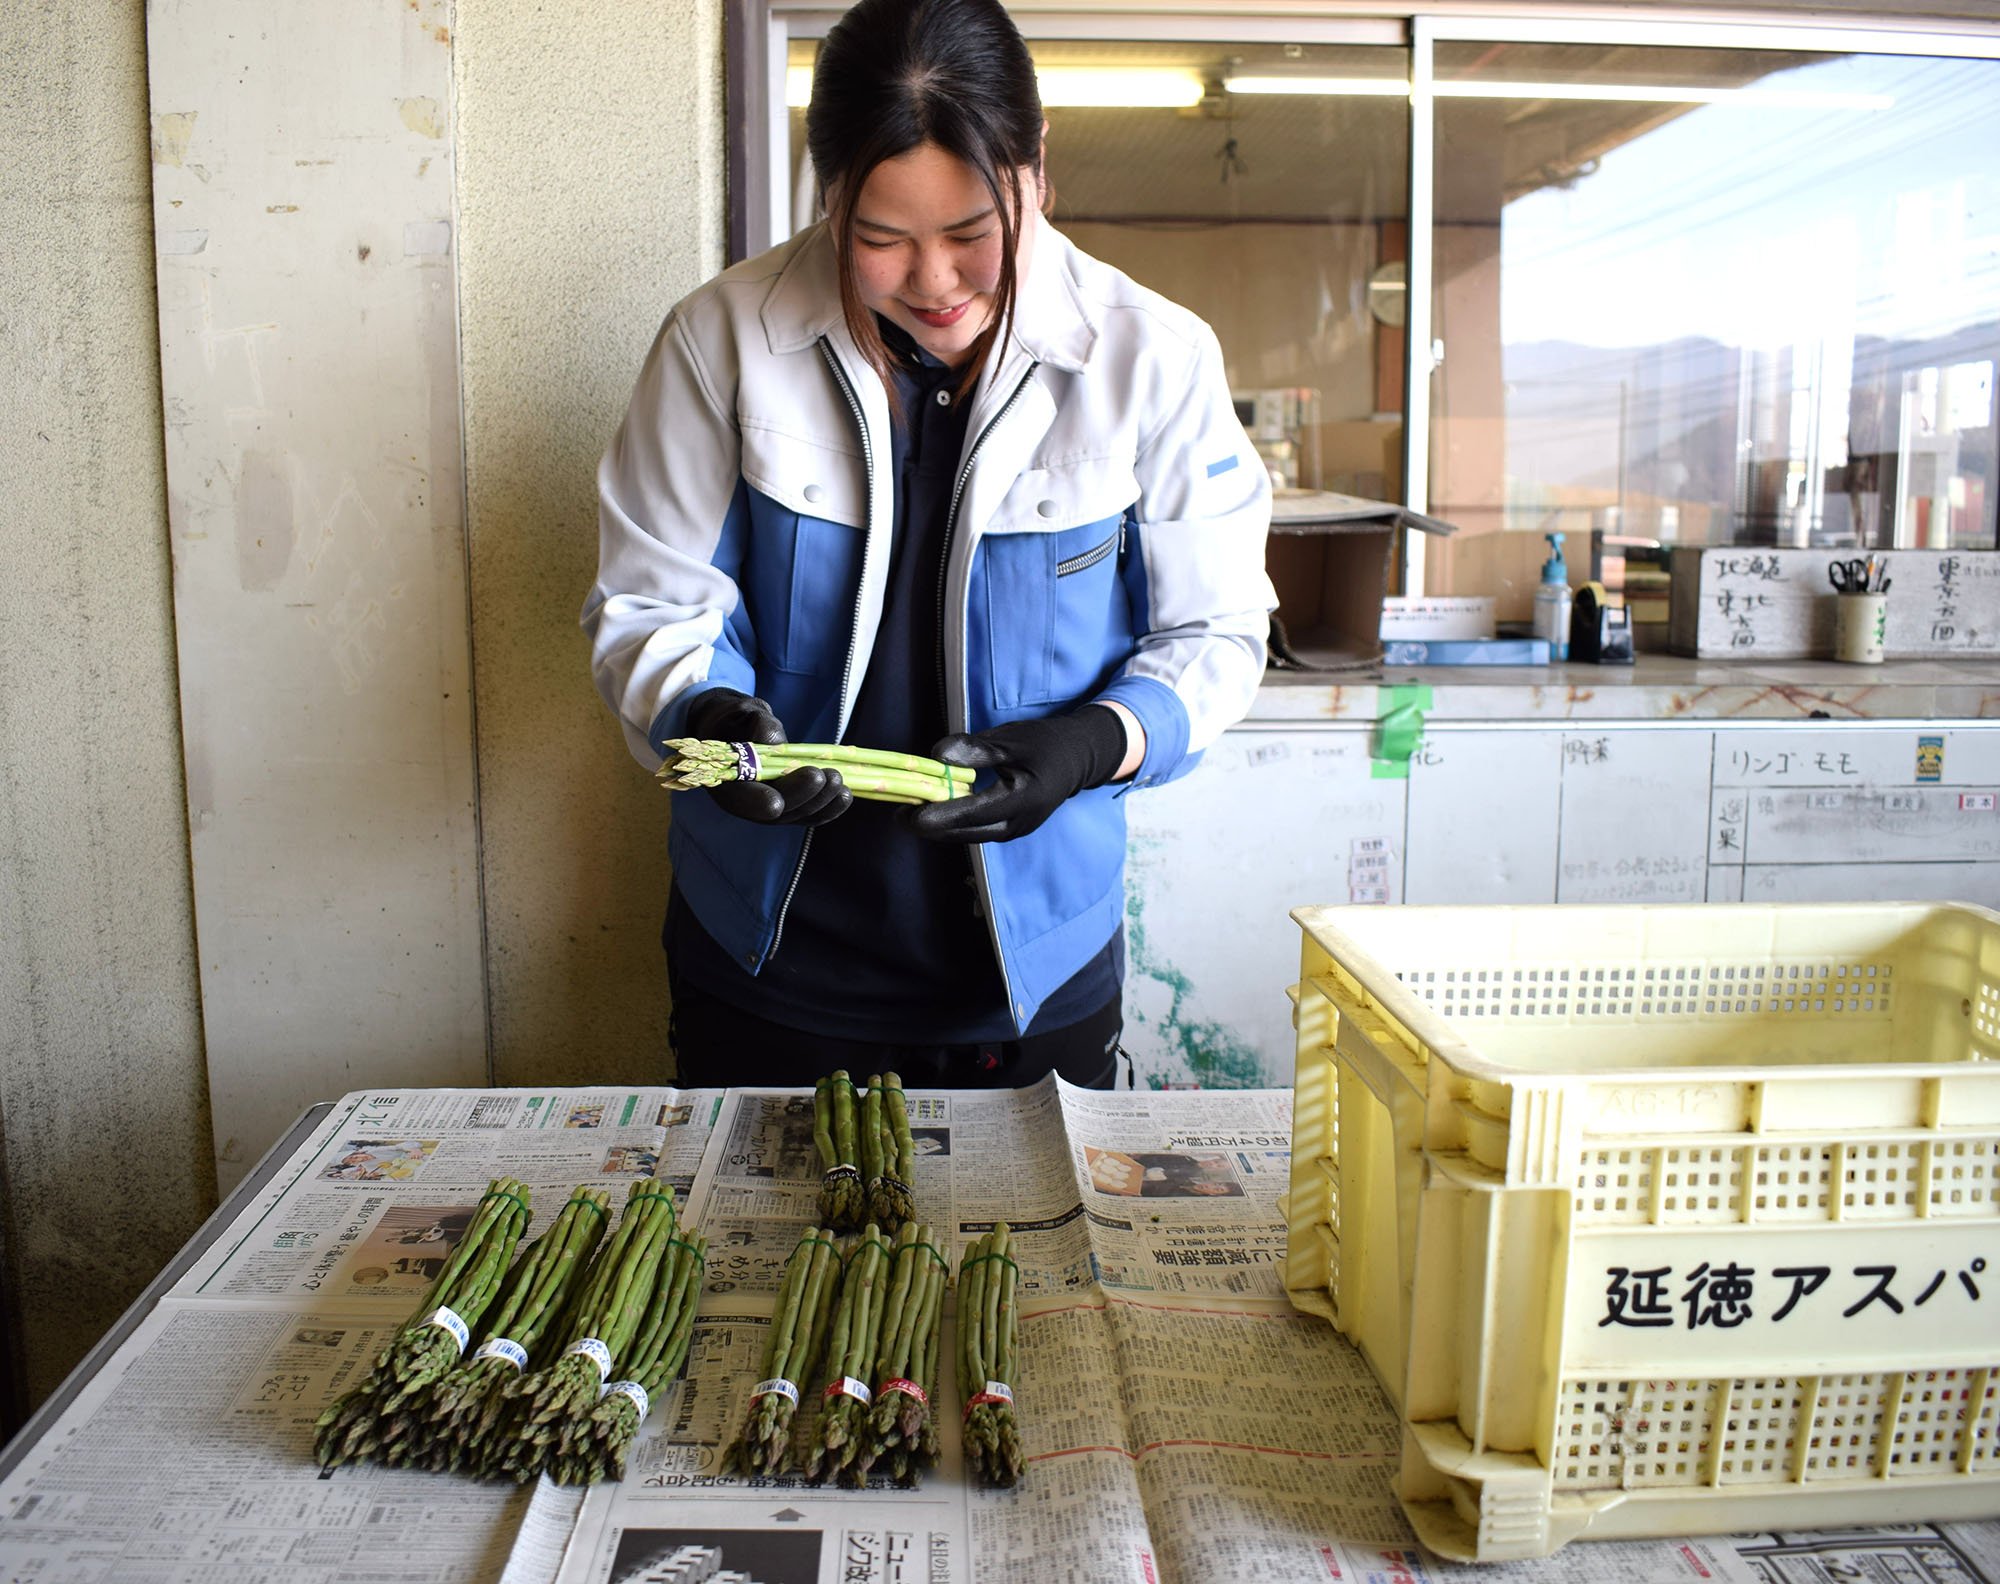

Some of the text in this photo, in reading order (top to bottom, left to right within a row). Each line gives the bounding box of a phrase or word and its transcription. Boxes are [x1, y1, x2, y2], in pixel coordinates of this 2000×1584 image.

[1598, 1257, 1988, 1330] 延徳アスパ
